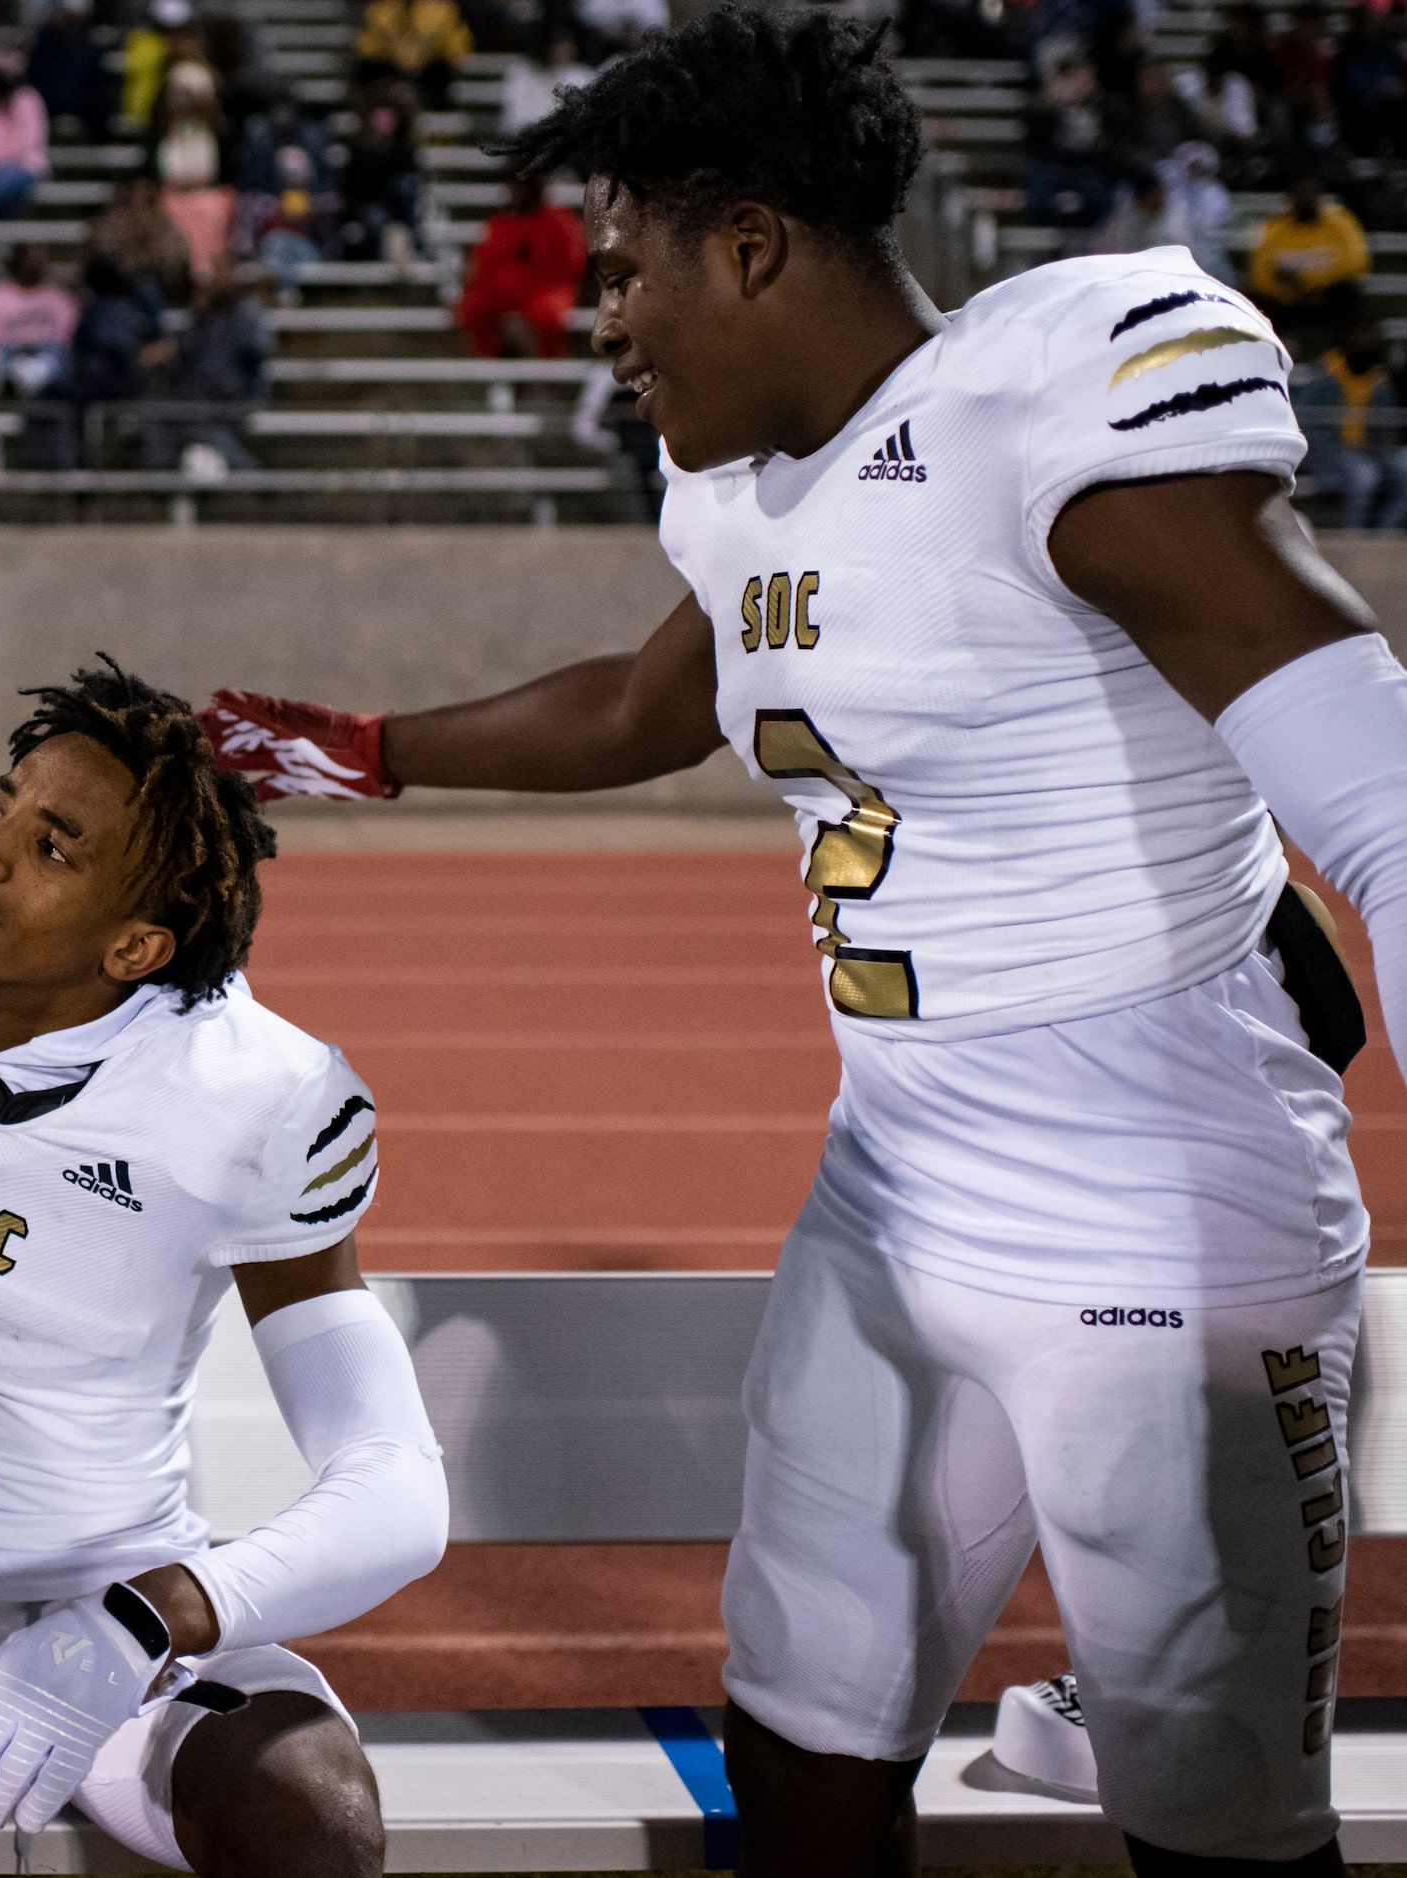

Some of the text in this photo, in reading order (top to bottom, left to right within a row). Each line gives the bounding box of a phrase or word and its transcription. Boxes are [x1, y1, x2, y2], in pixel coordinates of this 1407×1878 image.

[858, 459, 927, 483] adidas
[741, 571, 820, 653] SOC
[754, 708, 919, 1020] 2
[62, 1168, 143, 1212] adidas
[1080, 1307, 1184, 1329] adidas
[1261, 1345, 1345, 1574] CLIFF
